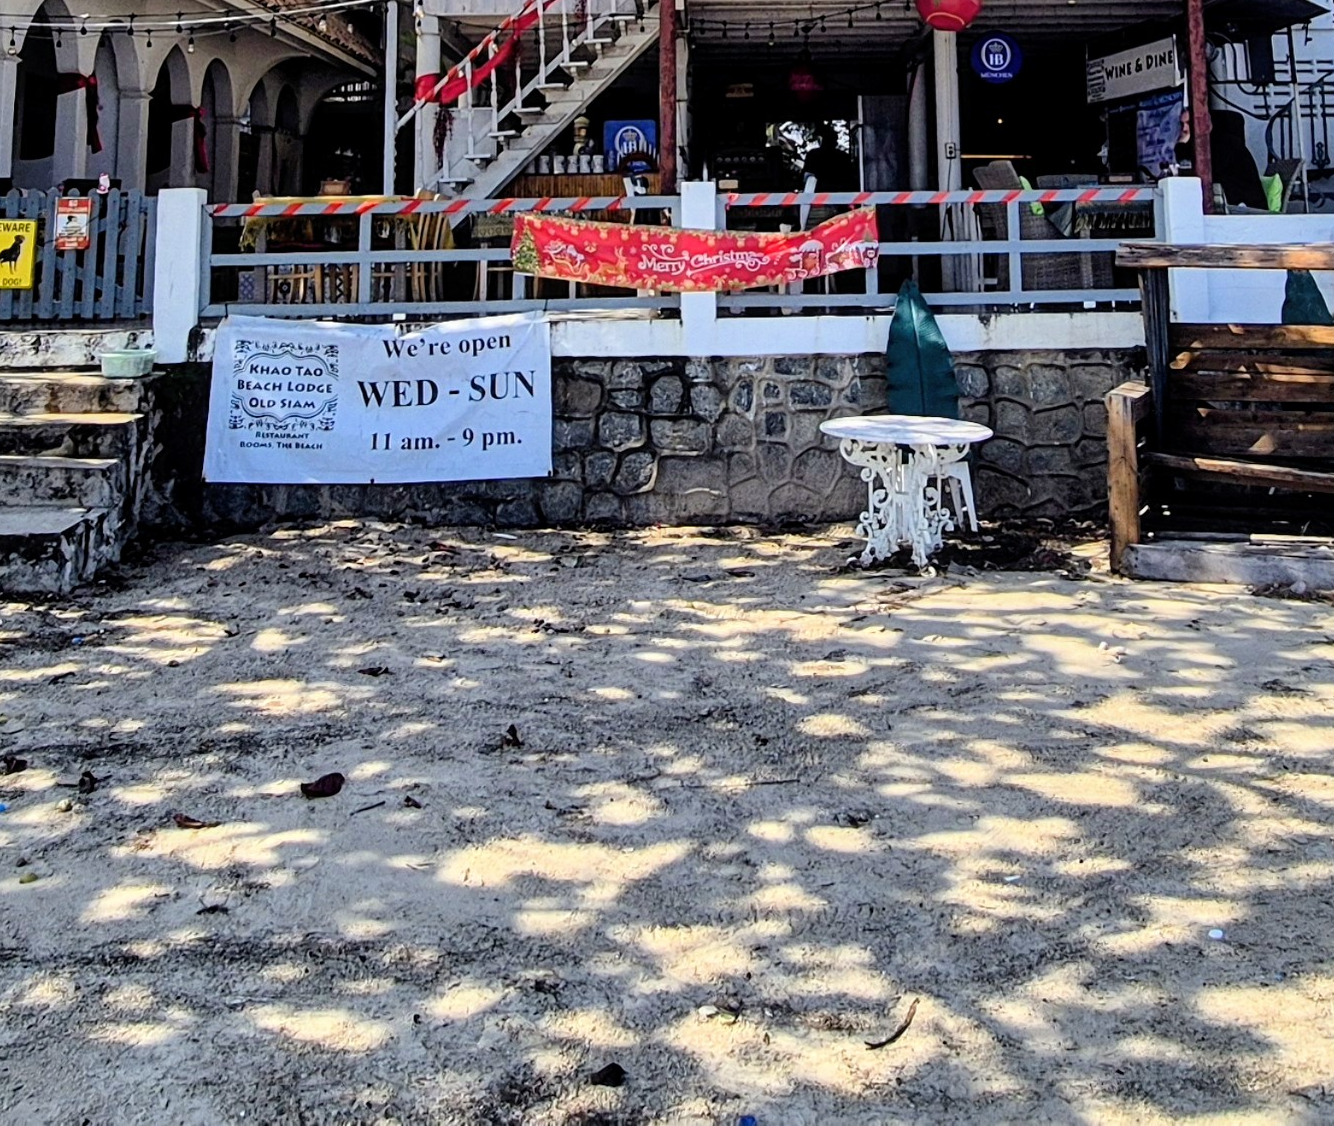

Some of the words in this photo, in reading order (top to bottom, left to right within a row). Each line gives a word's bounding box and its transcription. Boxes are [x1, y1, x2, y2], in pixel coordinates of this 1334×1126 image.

[1105, 62, 1132, 81] WINE
[1135, 57, 1143, 73] &
[1146, 50, 1174, 70] DINE
[638, 250, 687, 276] Merry
[382, 338, 451, 358] We're
[458, 334, 511, 356] open
[249, 364, 292, 376] KHAO
[295, 366, 324, 377] TAO
[237, 379, 283, 392] BEACH
[287, 381, 333, 394] LODGE
[357, 379, 439, 408] WED
[468, 370, 537, 402] SUN
[248, 397, 276, 408] OLD
[280, 398, 316, 409] SIAM
[255, 431, 310, 440] RESTAURANT
[371, 432, 392, 451] 11
[400, 436, 441, 451] am.
[462, 427, 474, 447] 9
[481, 430, 523, 452] pm.
[276, 441, 293, 450] THE
[295, 441, 323, 450] BEACH
